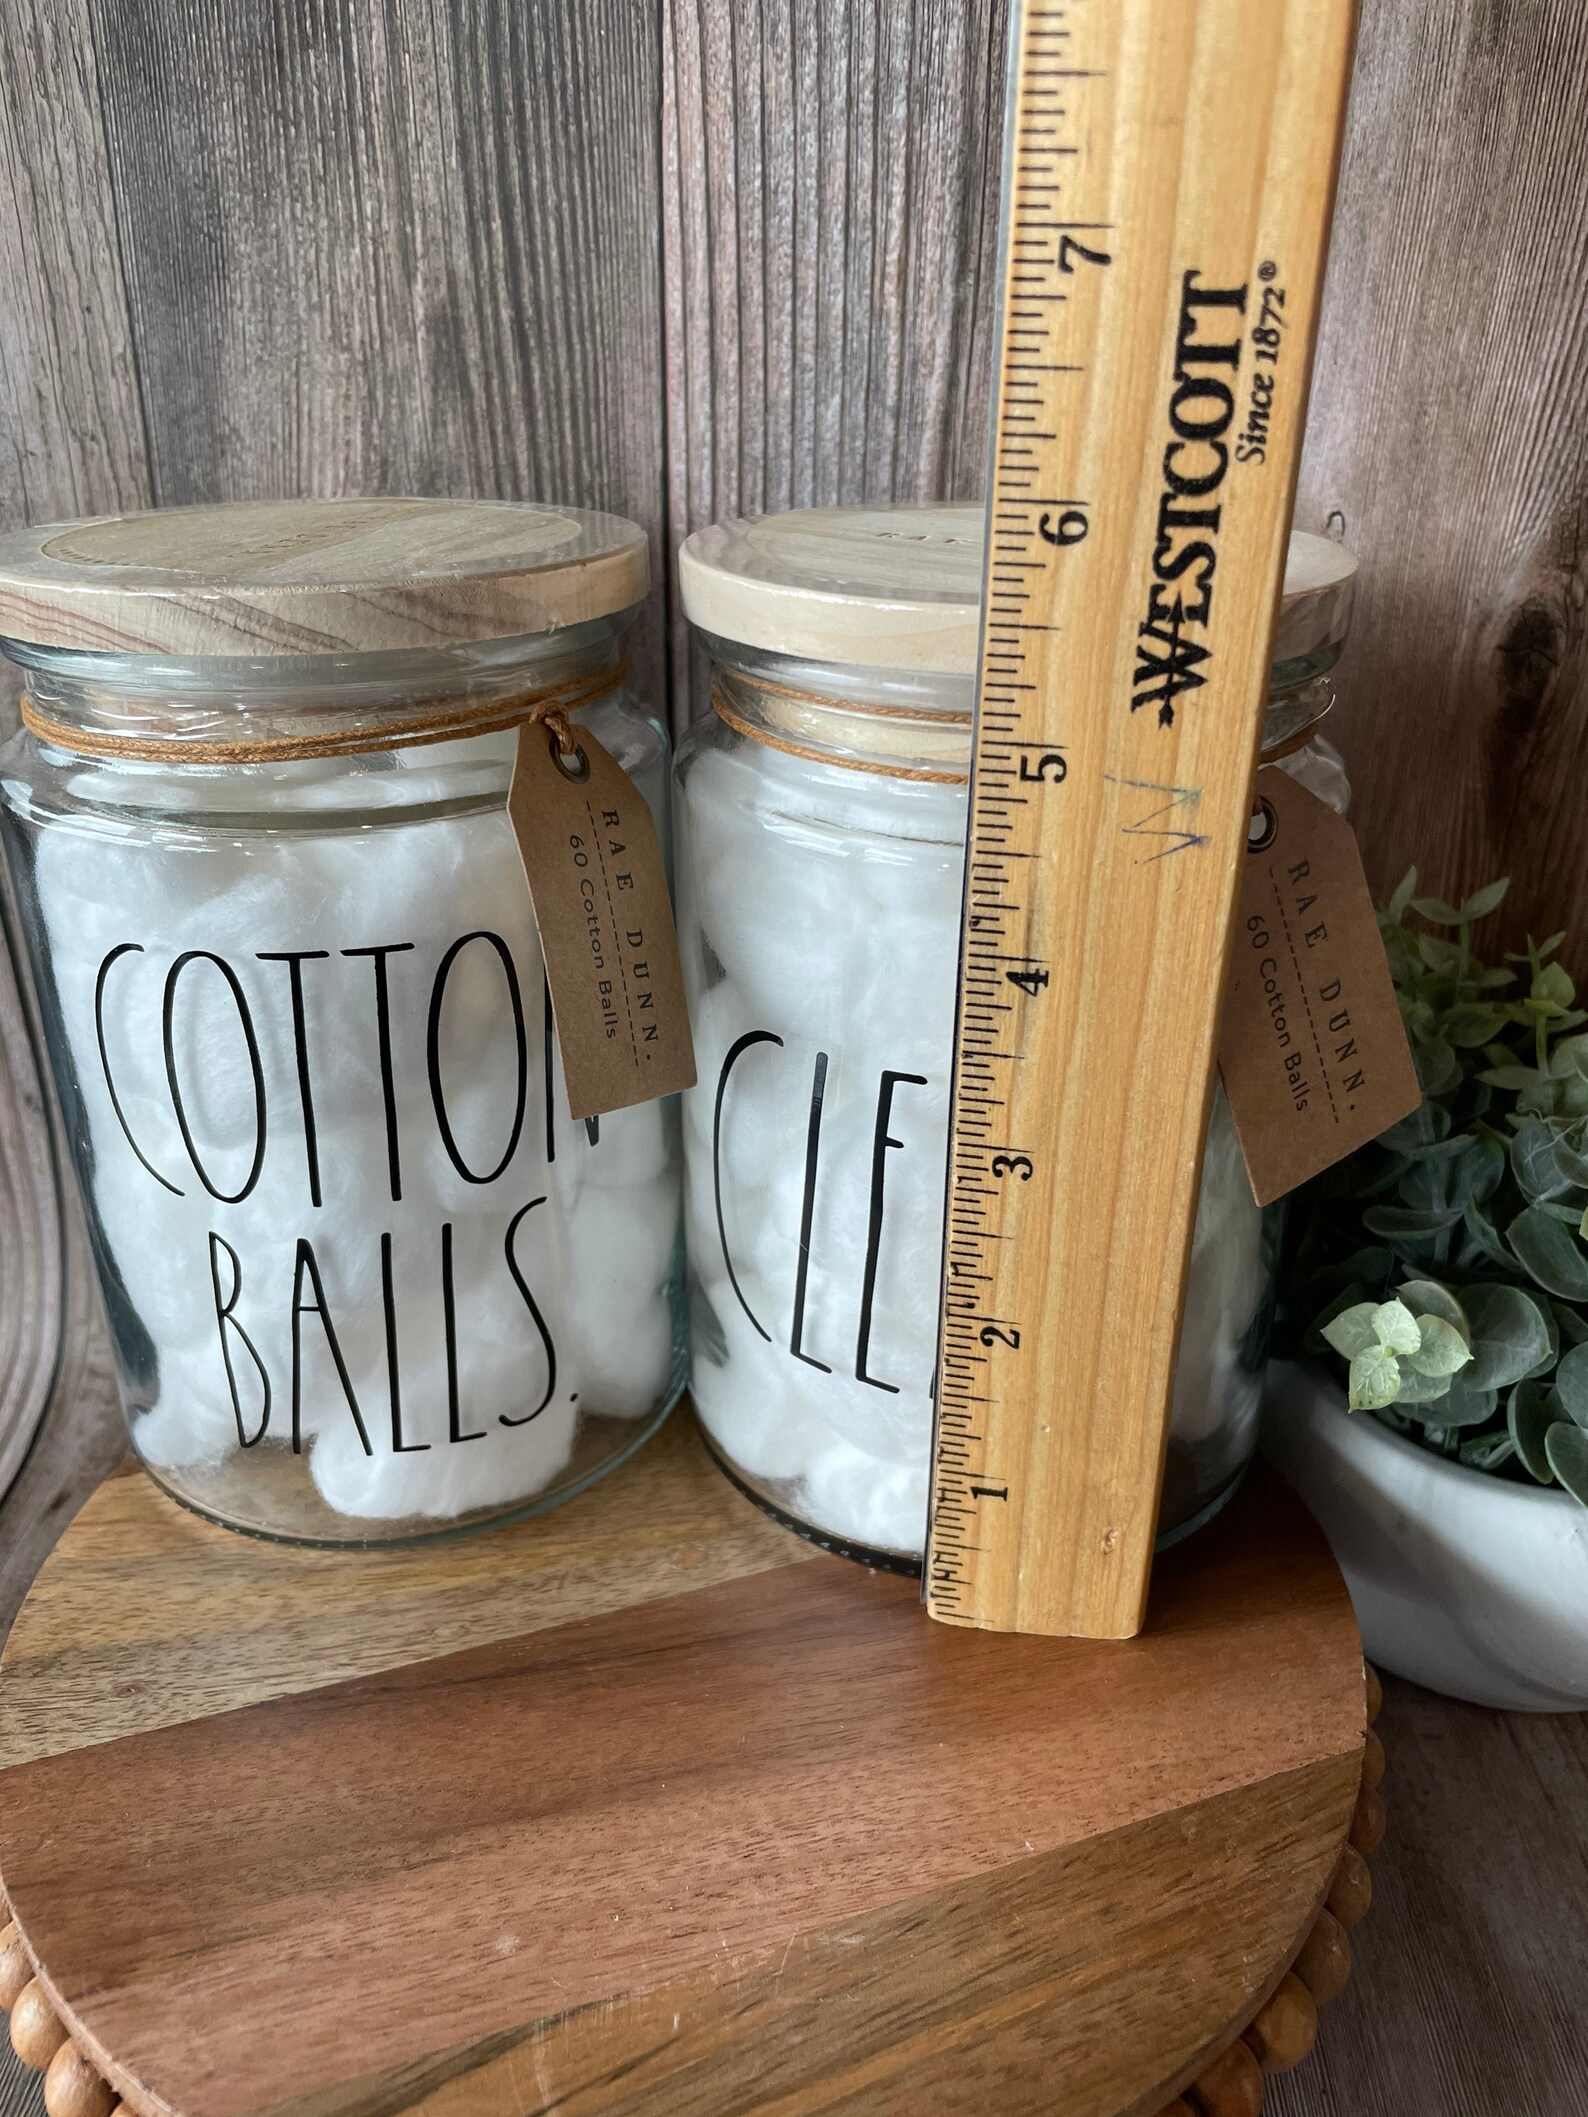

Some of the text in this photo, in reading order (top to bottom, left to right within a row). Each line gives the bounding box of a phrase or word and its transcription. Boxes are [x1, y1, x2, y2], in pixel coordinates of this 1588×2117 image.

[1058, 235, 1112, 274] 7
[1235, 373, 1275, 466] Since
[1038, 510, 1089, 547] 6
[1131, 269, 1249, 714] WESTCOTT
[1020, 752, 1067, 785] 5
[569, 834, 617, 1040] 60 Cotton Balls
[601, 808, 660, 1061] RAE DUNN.
[1005, 968, 1050, 997] 4
[1246, 914, 1309, 1113] 60 Cotton Balls
[1287, 858, 1366, 1112] RAE DUNN.
[713, 1029, 937, 1401] CLE
[991, 1155, 1034, 1182] 3
[208, 1195, 579, 1457] BALLS.
[979, 1325, 1021, 1350] 2
[970, 1485, 1008, 1502] 1
